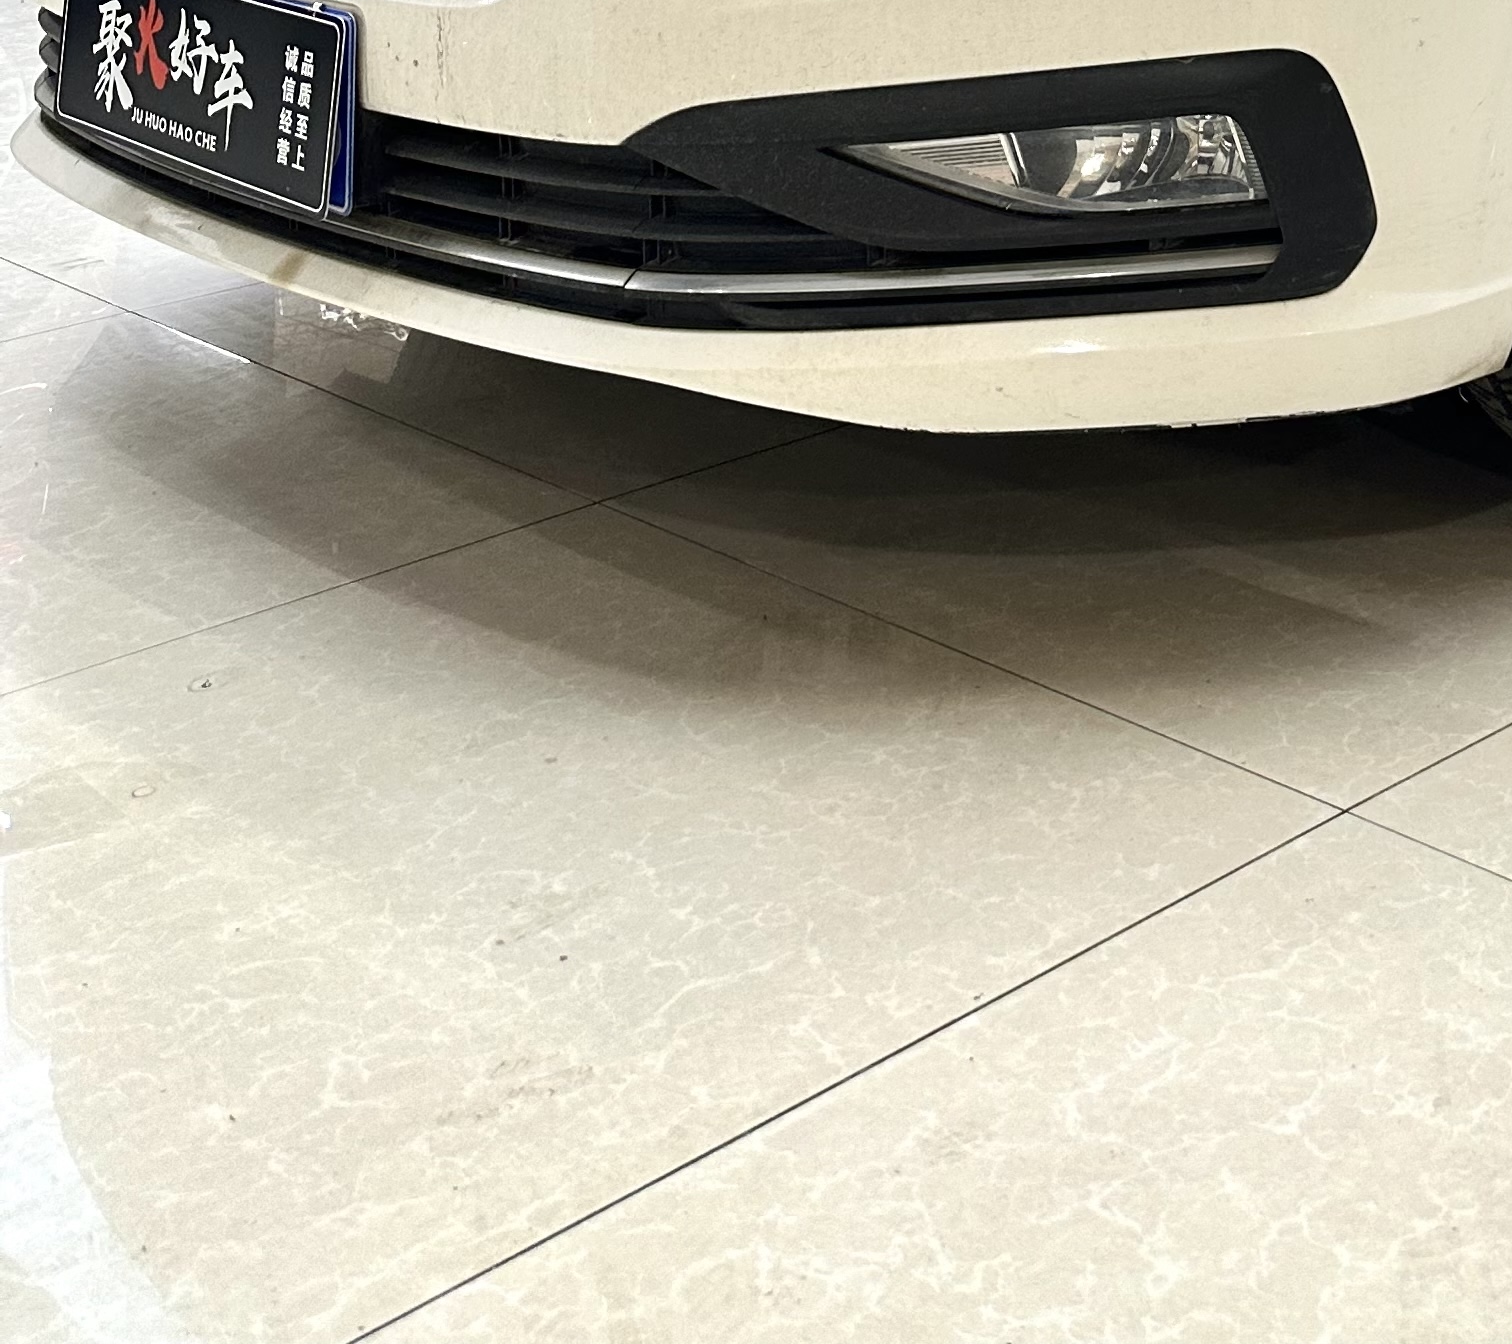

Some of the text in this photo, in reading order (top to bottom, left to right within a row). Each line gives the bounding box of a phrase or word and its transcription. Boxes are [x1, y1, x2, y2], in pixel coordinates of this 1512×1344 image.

[131, 106, 217, 152] JU HUO HAO CHE
[276, 44, 299, 166] 诚信经营
[291, 50, 314, 172] 品质至上
